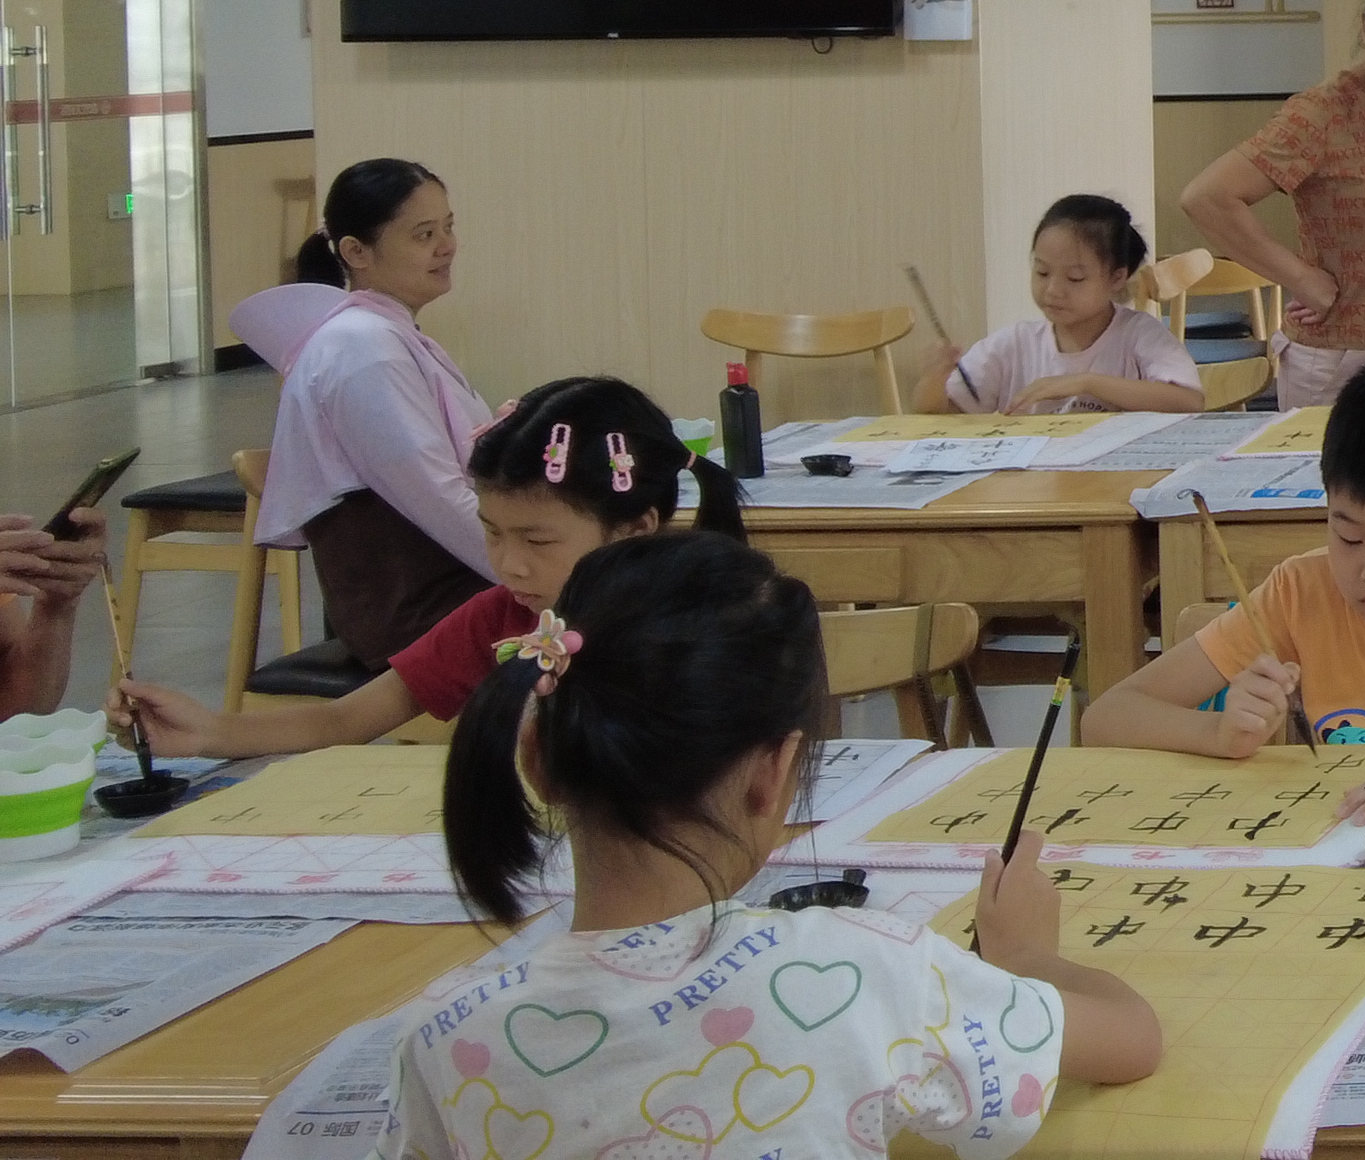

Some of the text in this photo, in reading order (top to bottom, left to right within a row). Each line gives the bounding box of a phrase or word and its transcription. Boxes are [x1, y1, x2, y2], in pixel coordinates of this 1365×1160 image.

[1315, 754, 1365, 774] 中
[1077, 783, 1134, 804] 中
[1170, 783, 1232, 808] 中
[1275, 781, 1330, 808] 中
[1128, 811, 1189, 834] 中
[1226, 809, 1290, 841] 中
[1130, 875, 1190, 907] 中
[1241, 873, 1306, 908] 中
[1086, 915, 1146, 948] 中
[1194, 916, 1267, 949] 中
[648, 926, 781, 1027] PRETTY
[419, 960, 530, 1049] PRETTY
[963, 1014, 1004, 1141] PRETTY
[287, 1120, 362, 1137] 国际 07
